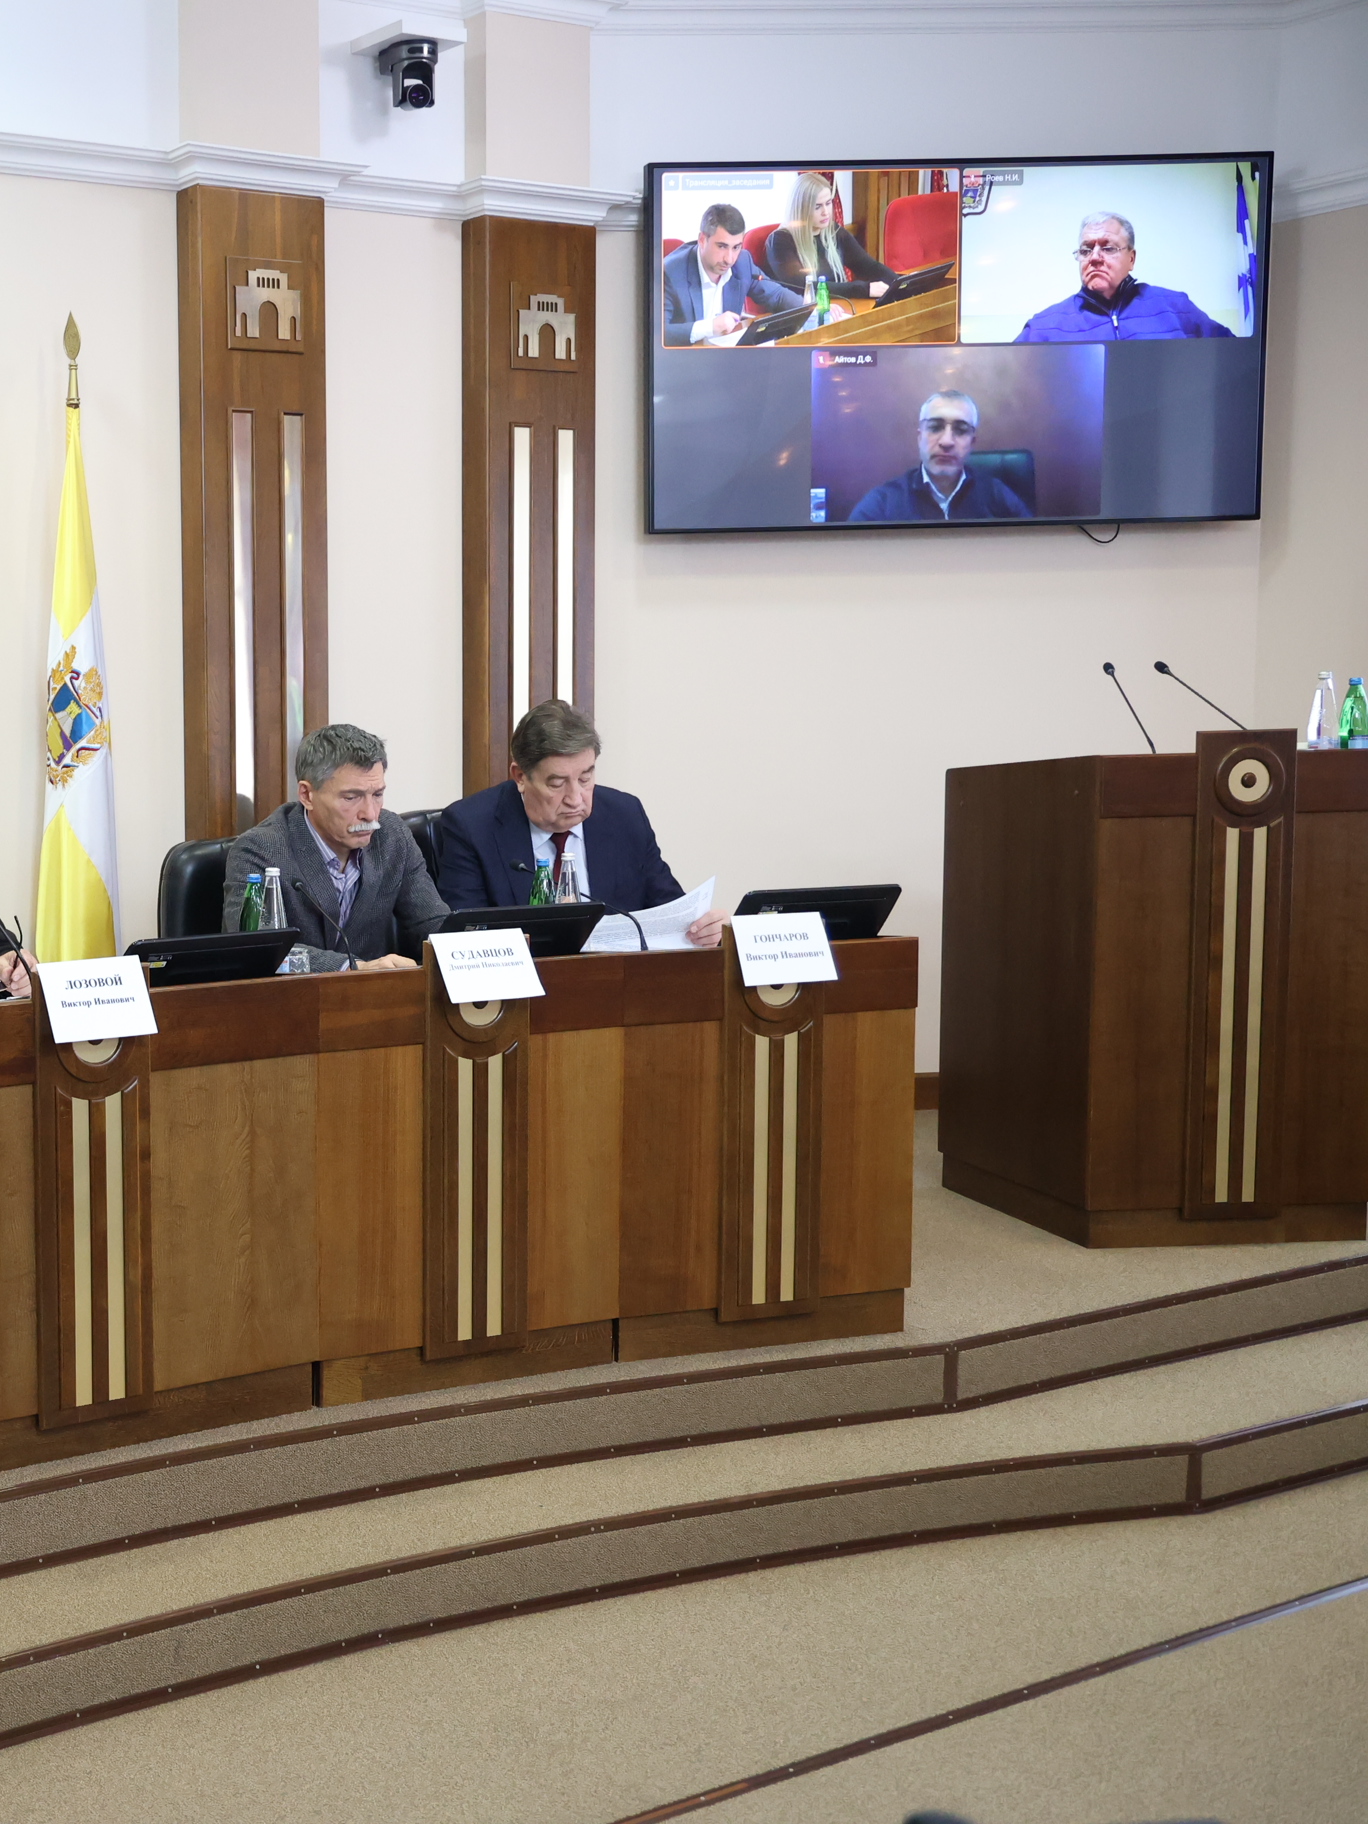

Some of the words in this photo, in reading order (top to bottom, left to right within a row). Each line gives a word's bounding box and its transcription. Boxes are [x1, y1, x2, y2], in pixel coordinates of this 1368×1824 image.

[753, 932, 809, 943] ГОНЧАРОВ
[451, 947, 514, 960] СУДАВЦОВ
[745, 952, 779, 962] Виктор
[780, 950, 825, 960] Иванович
[448, 962, 480, 971] Дмитрий
[481, 960, 524, 969] Николаевич
[65, 974, 123, 990] ЛОЗОВОЙ
[60, 999, 92, 1008] Виктор
[93, 996, 135, 1005] Иванович
